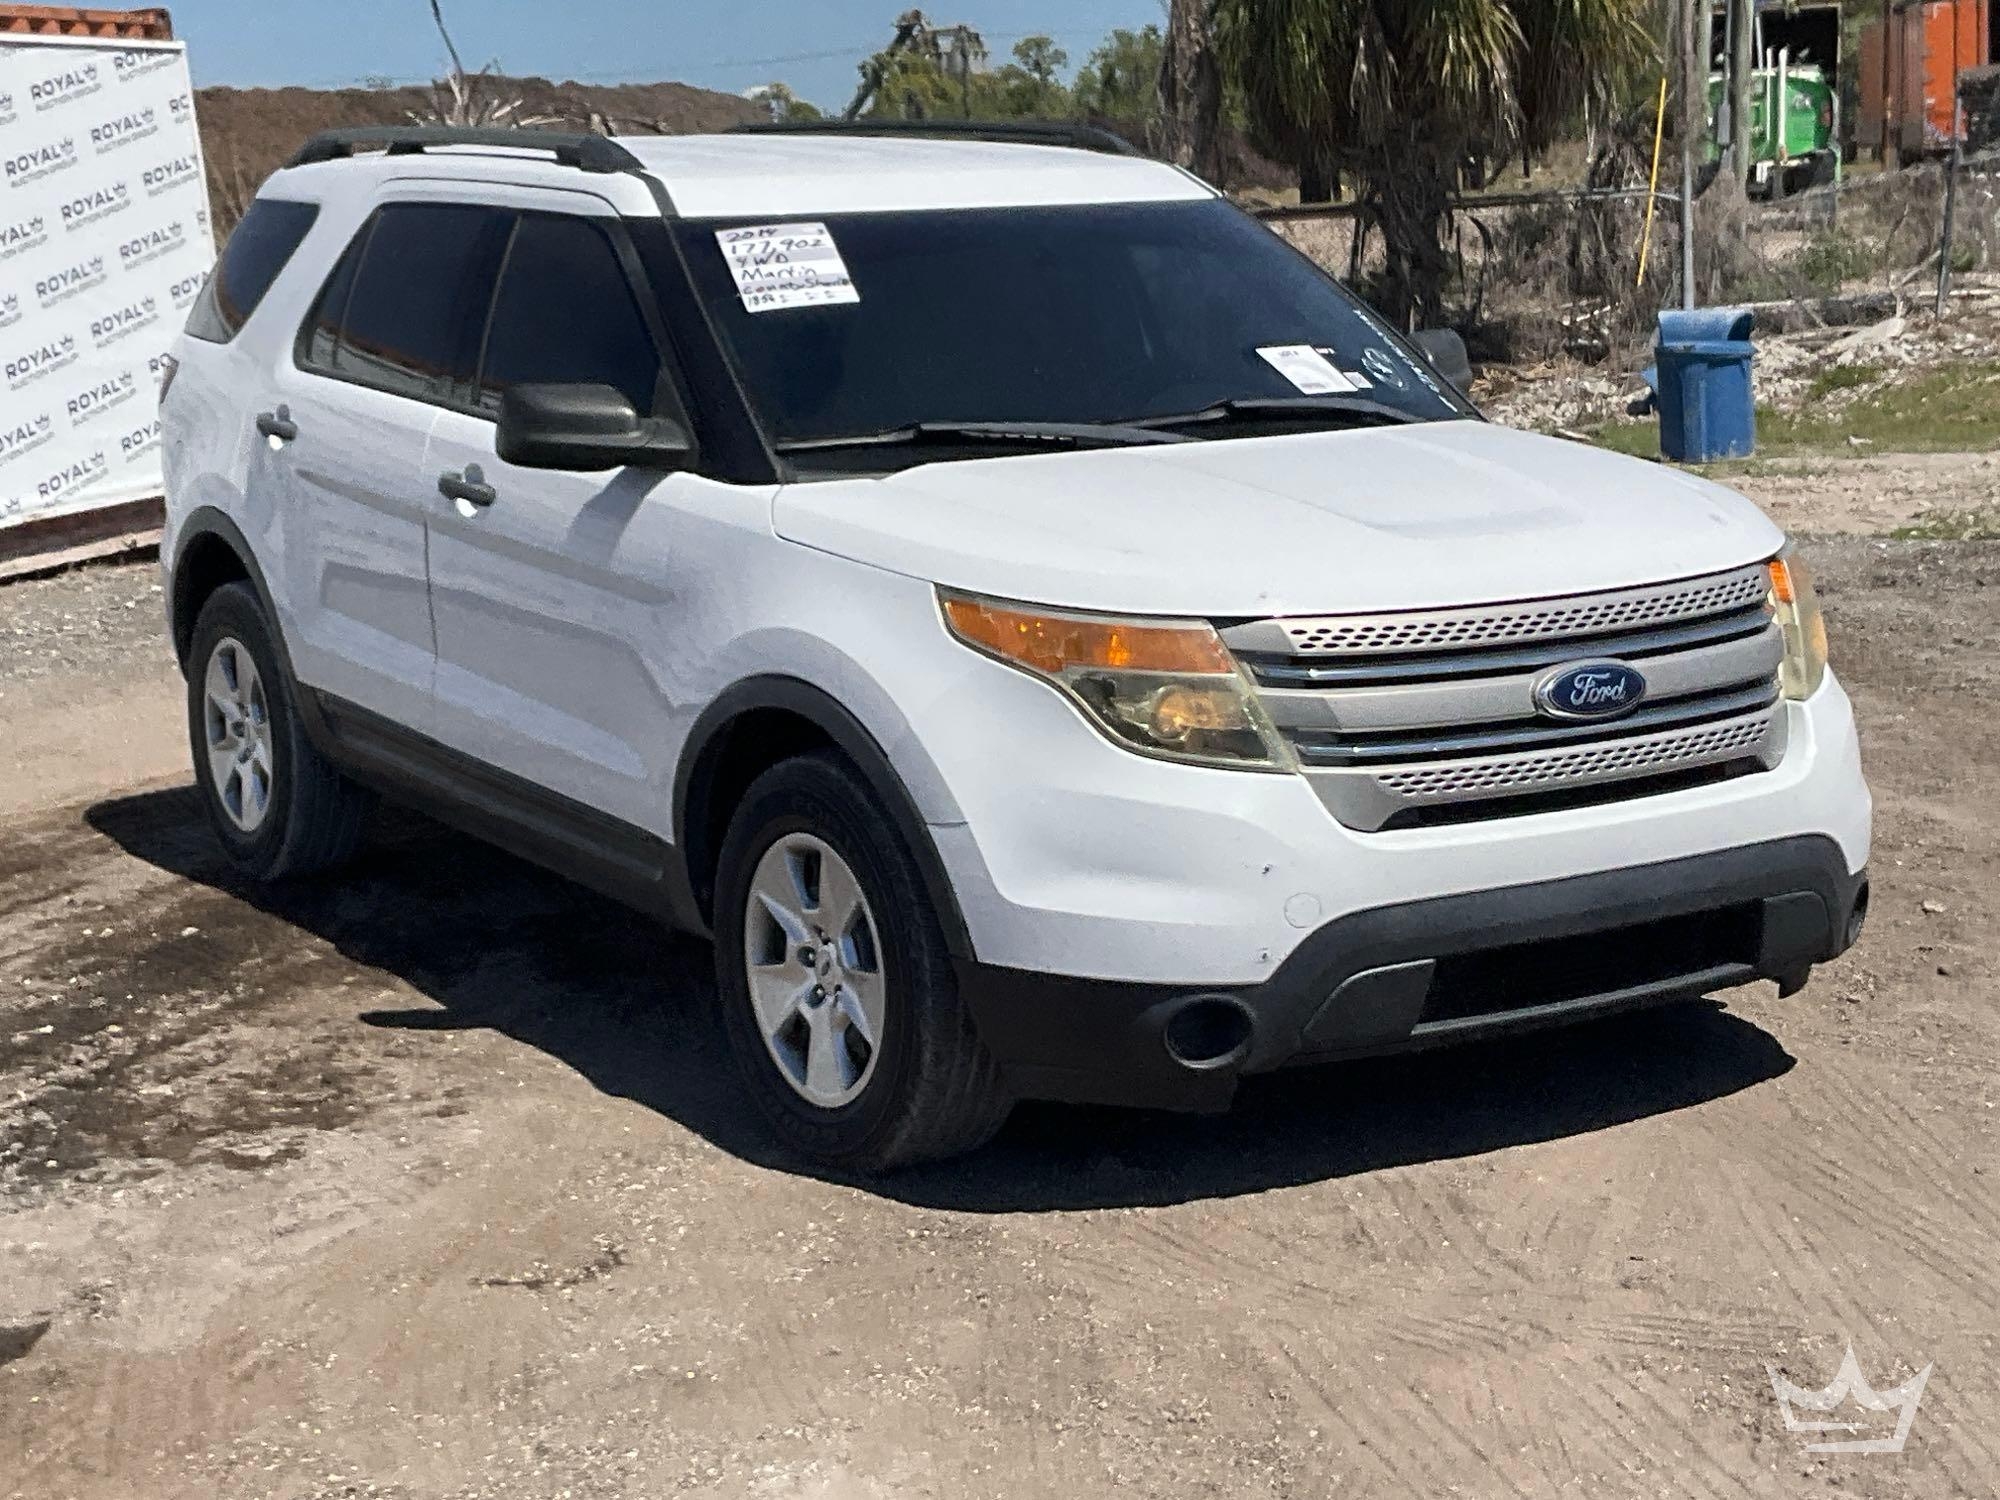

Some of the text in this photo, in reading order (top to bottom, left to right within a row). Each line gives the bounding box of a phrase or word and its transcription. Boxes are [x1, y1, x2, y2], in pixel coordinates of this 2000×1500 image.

[30, 71, 84, 99] ROYAL
[91, 115, 142, 142] ROYAL
[5, 145, 60, 176] ROYAL
[143, 158, 191, 185] ROYAL
[61, 188, 114, 220] ROYAL
[0, 224, 30, 246] YAL
[120, 229, 170, 258] ROYAL
[36, 264, 90, 298] ROYAL
[170, 271, 208, 300] ROYA
[91, 304, 143, 338] ROYAL
[6, 344, 62, 380] ROYAL
[67, 380, 121, 416] ROYAL
[121, 420, 161, 452] ROYA
[38, 460, 92, 497] ROYAL
[1571, 672, 1625, 706] Ford
